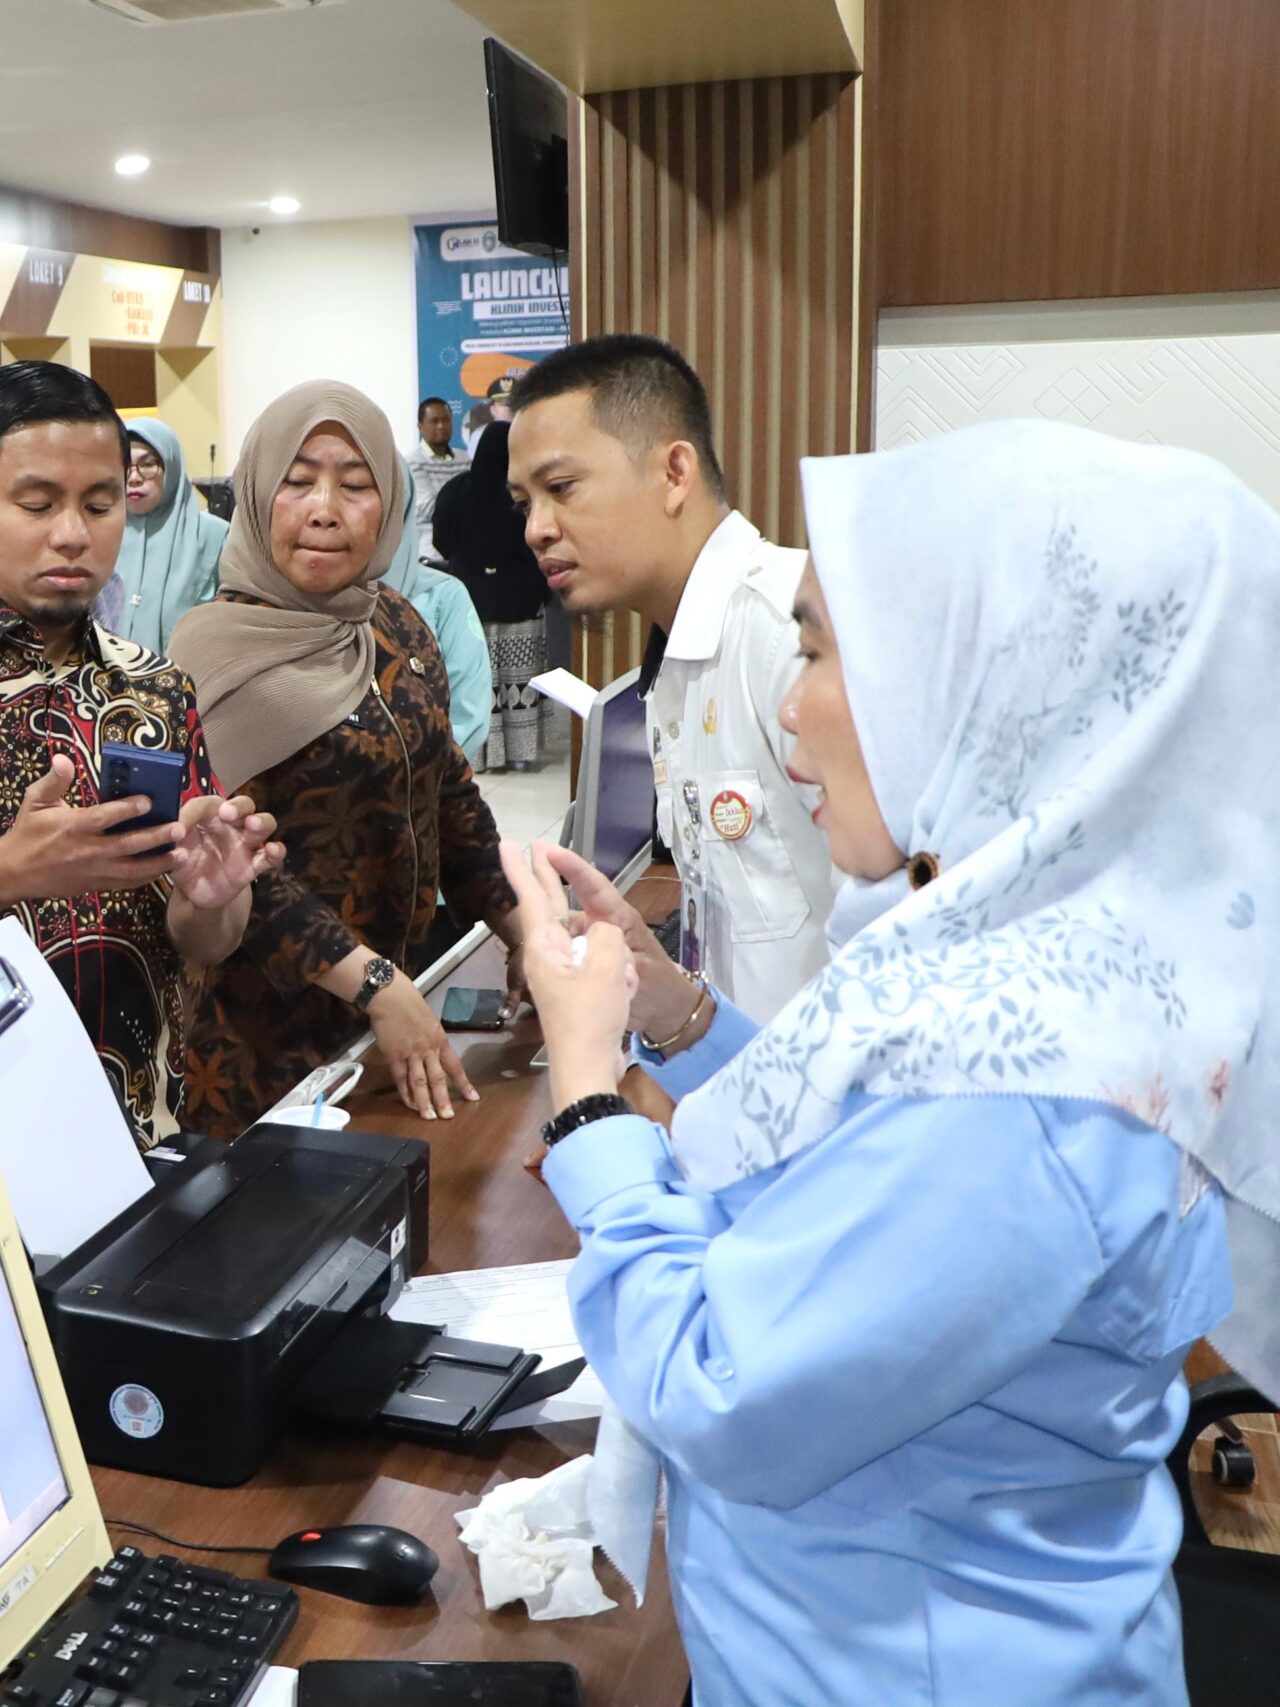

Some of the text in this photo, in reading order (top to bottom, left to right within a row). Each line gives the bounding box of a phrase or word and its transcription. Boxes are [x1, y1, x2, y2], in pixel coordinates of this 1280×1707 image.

[29, 259, 64, 287] LOKET 9
[491, 302, 524, 315] KLINIK
[54, 1632, 88, 1660] DELL
